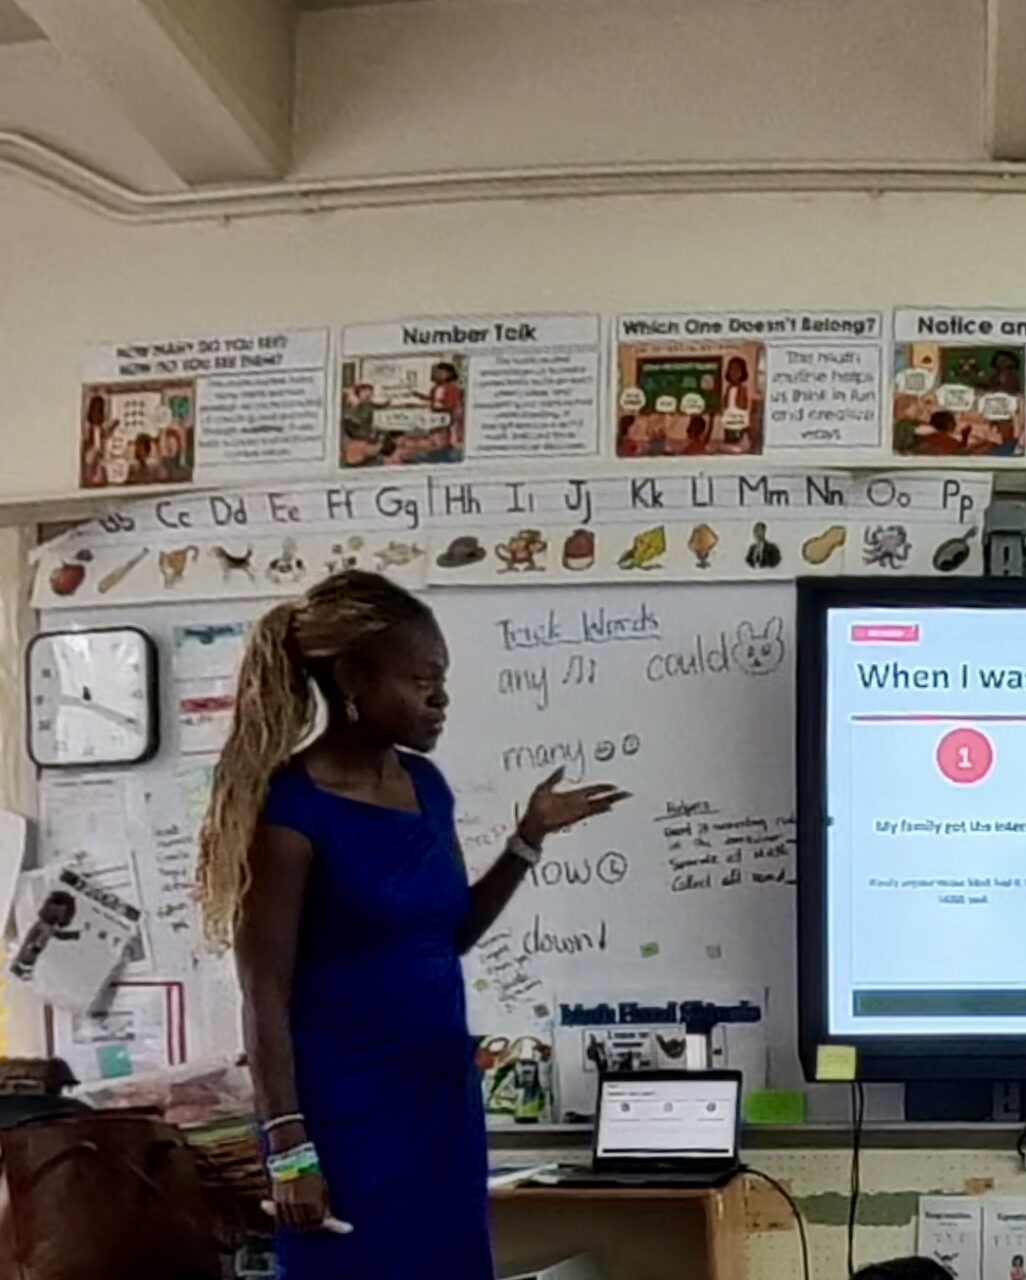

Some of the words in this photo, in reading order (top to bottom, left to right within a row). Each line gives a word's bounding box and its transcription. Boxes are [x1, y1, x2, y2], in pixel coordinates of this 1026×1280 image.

[402, 325, 489, 345] Number
[493, 322, 538, 342] Talk
[623, 318, 680, 336] Which
[685, 318, 724, 335] One
[728, 316, 797, 334] Doesn't
[801, 316, 877, 336] Belong?
[917, 316, 993, 336] Notice
[156, 500, 193, 529] Cc
[210, 496, 248, 527] Dd
[267, 493, 302, 523] Ee
[327, 489, 354, 519] Ff
[375, 486, 420, 530] Gg
[445, 483, 482, 515] Hh
[564, 480, 592, 525] Jj
[630, 478, 665, 508] Kk
[738, 475, 790, 507] Mm
[805, 476, 844, 506] Nn
[866, 478, 912, 508] Oo
[942, 479, 974, 524] Pp
[646, 631, 730, 682] could
[857, 662, 950, 690] When
[961, 663, 968, 690] I
[498, 666, 549, 711] any
[502, 738, 585, 785] many
[957, 746, 973, 769] 1
[523, 913, 594, 955] down
